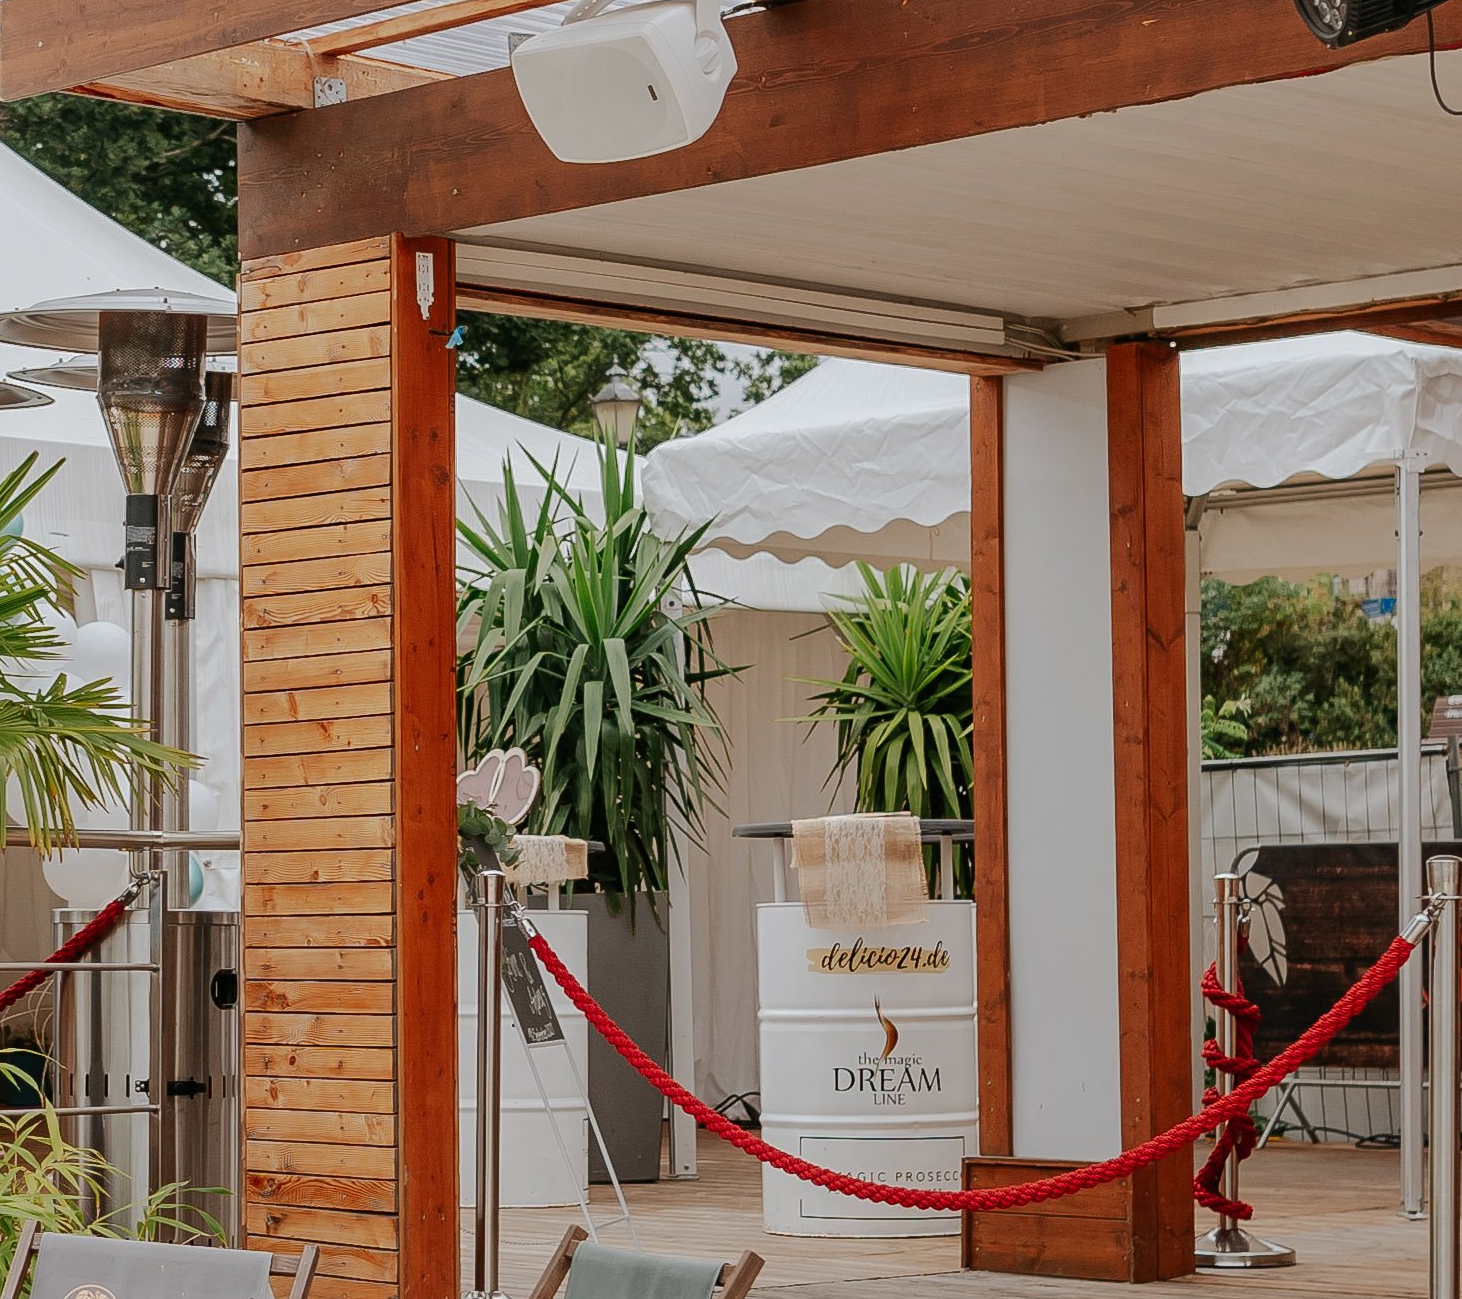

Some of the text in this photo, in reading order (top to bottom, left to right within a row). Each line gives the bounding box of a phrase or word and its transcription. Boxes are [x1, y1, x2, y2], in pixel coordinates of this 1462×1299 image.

[821, 936, 951, 972] delicio24.de
[858, 1052, 923, 1068] the magic
[833, 1067, 942, 1092] DREAM
[874, 1093, 906, 1105] LINE
[895, 1170, 962, 1183] PROSECC
